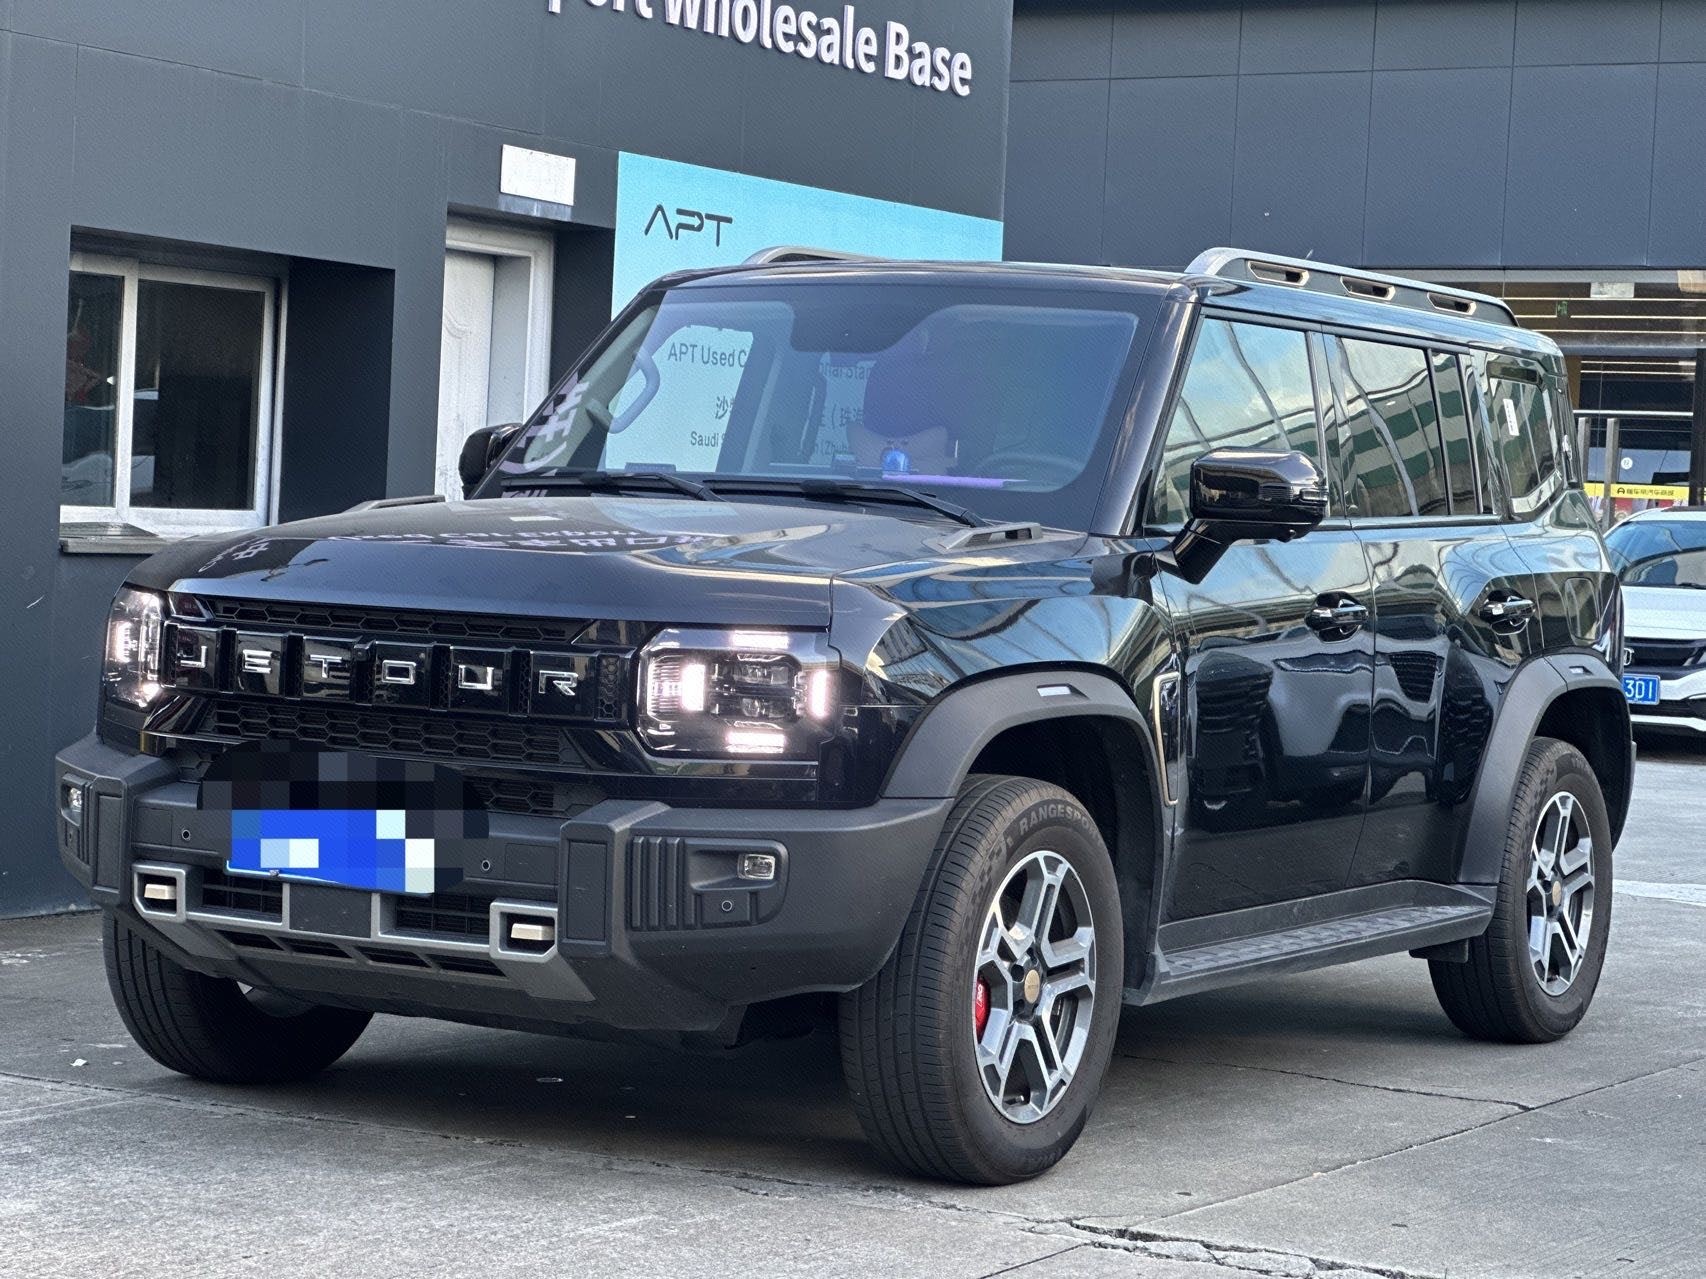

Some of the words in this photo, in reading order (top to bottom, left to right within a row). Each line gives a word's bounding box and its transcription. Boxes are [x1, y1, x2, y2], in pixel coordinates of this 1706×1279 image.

[885, 21, 972, 97] Base
[644, 203, 733, 247] APT
[668, 342, 698, 364] APT
[701, 345, 736, 368] Used
[715, 395, 735, 419] 沙
[690, 430, 719, 447] Saudi
[180, 645, 578, 696] JETOUR
